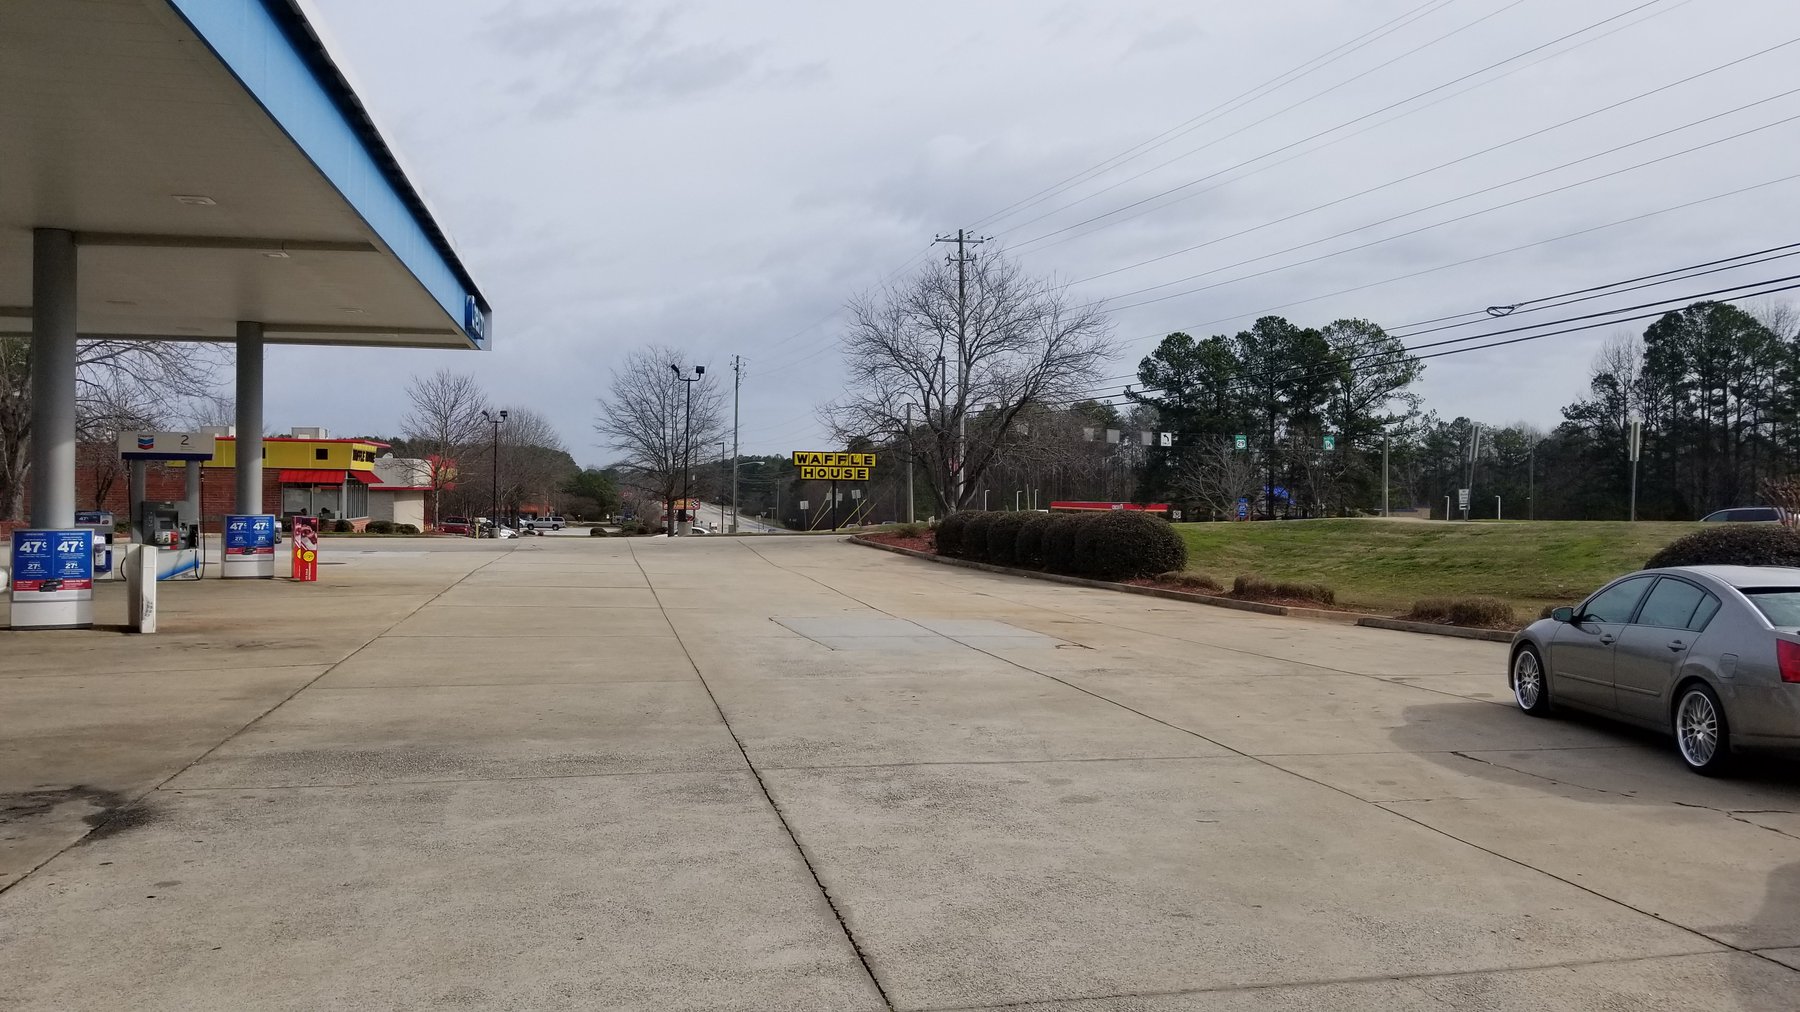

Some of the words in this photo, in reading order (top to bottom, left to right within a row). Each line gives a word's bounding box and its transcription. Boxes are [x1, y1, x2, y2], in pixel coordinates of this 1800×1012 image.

[180, 435, 189, 445] 2
[796, 454, 873, 465] WAFFLE
[803, 468, 867, 479] HOUSE
